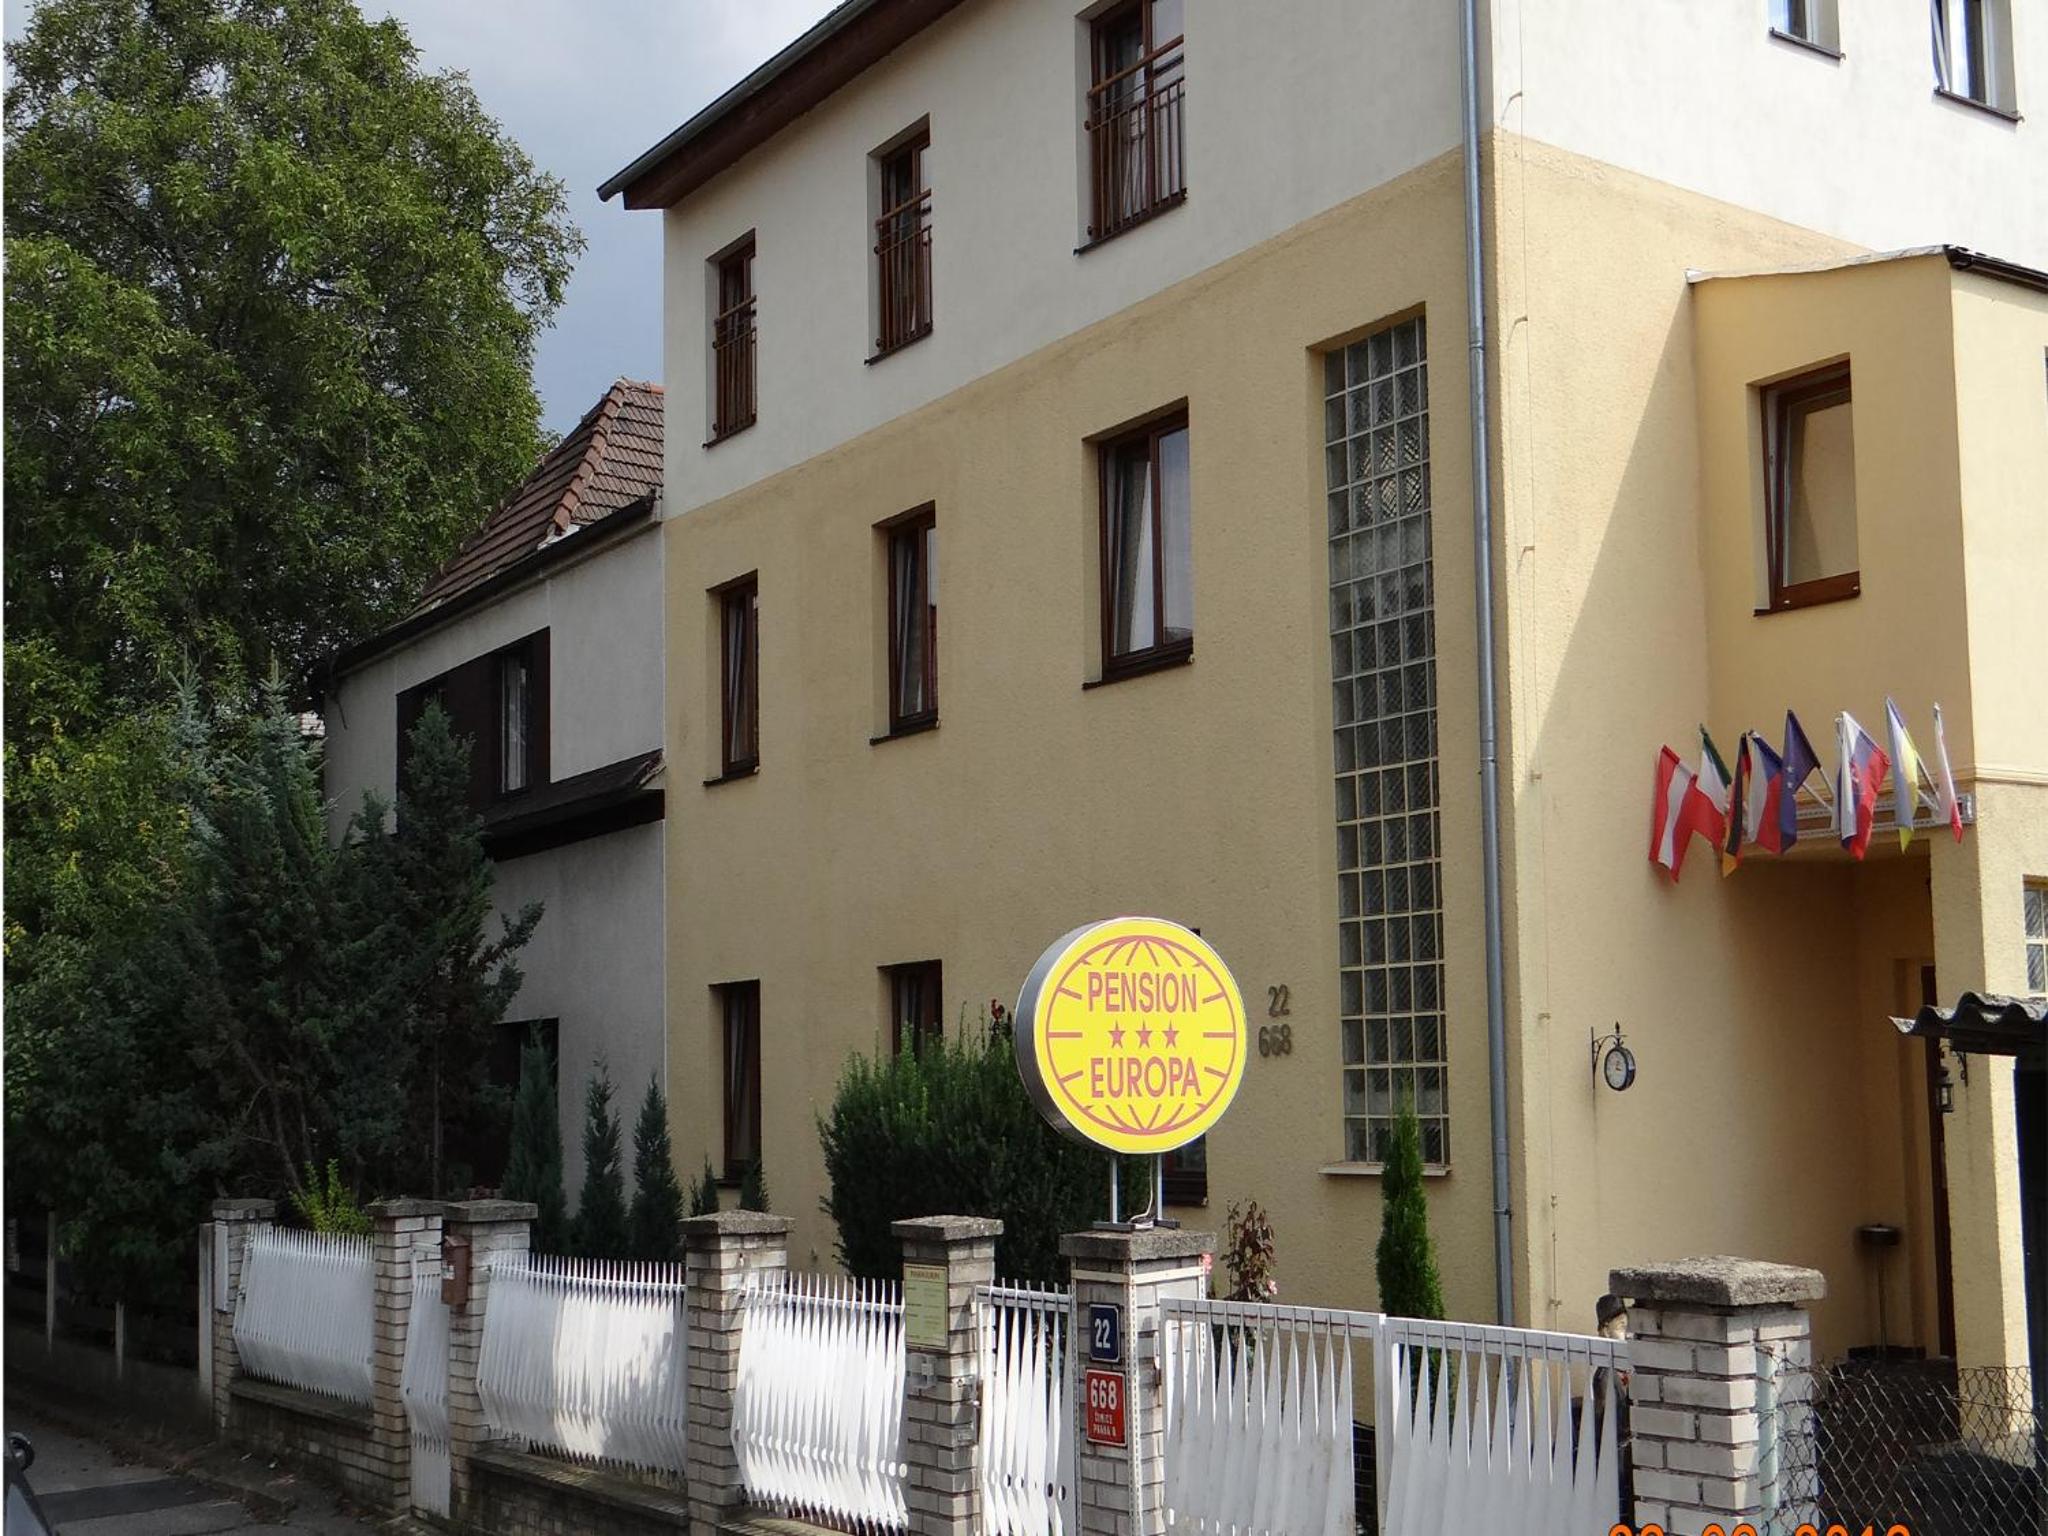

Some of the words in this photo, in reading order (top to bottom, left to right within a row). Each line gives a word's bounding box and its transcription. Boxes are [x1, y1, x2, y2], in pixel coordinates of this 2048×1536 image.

[1088, 971, 1197, 1013] PENSION
[1268, 984, 1290, 1017] 22
[1258, 1023, 1292, 1058] 668
[1090, 1056, 1201, 1098] EUROPA
[1094, 1318, 1111, 1349] 22
[1090, 1378, 1117, 1410] 668
